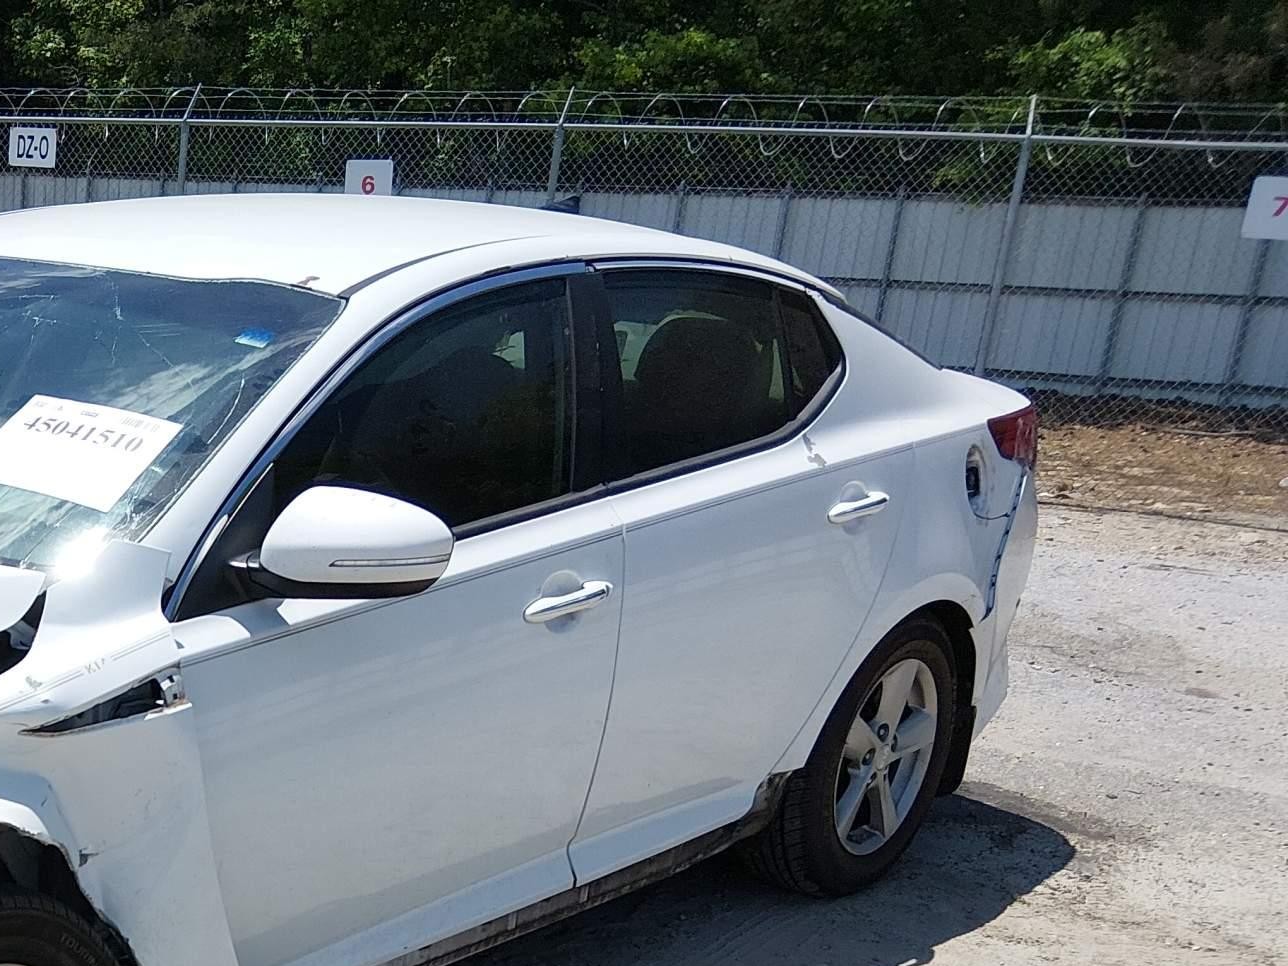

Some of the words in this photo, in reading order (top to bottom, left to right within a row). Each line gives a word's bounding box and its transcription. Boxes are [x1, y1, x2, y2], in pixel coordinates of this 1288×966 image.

[361, 175, 375, 195] 6
[1272, 195, 1288, 217] 7
[23, 416, 144, 452] 45041510
